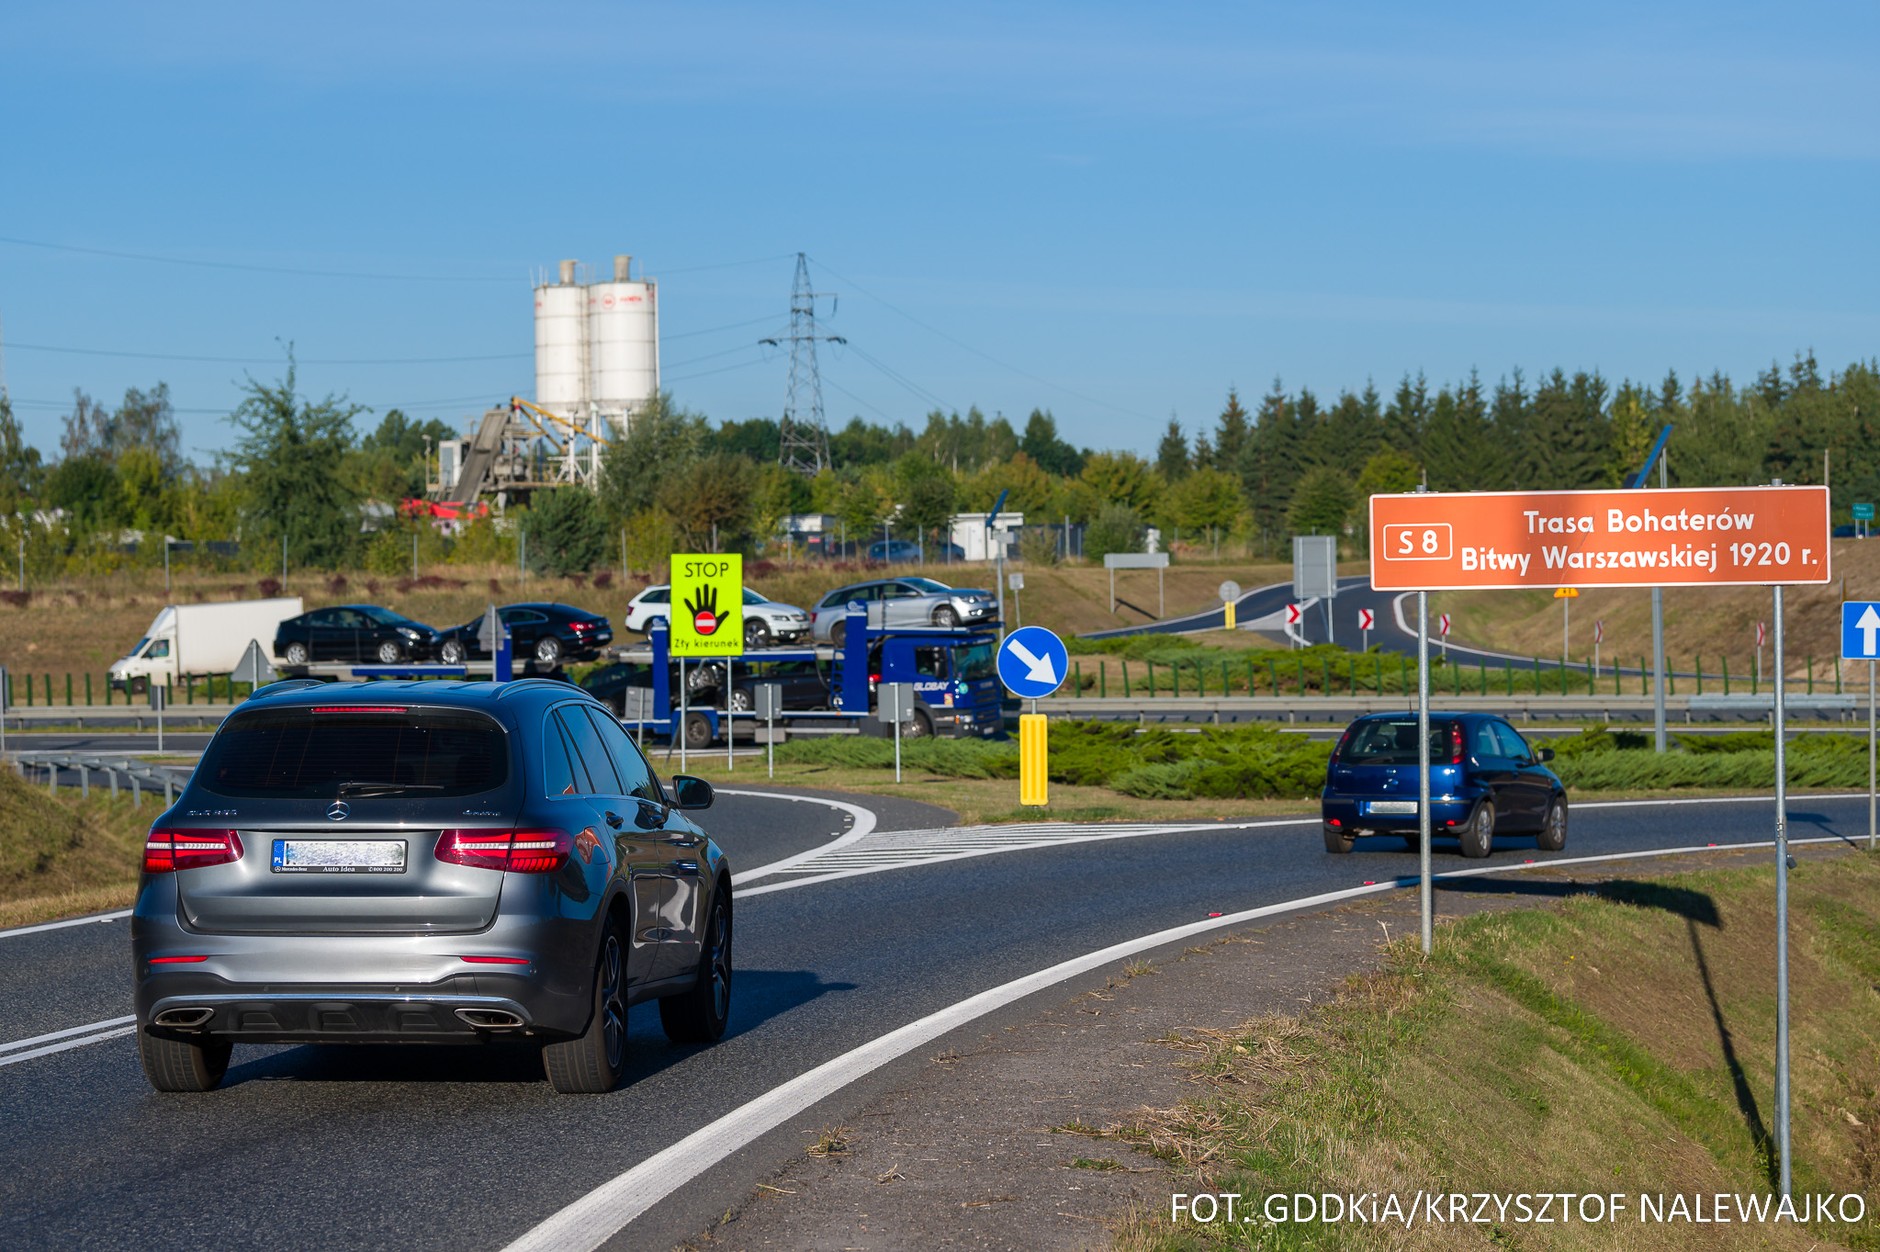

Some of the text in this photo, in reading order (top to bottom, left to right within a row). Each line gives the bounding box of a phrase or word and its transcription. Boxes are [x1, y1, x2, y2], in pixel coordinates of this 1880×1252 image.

[1523, 507, 1755, 534] Trasa Bohaterów
[1398, 529, 1439, 555] S 8
[1461, 541, 1818, 577] Bitwy Warszawskiej 1920 r.
[684, 562, 729, 578] STOP
[674, 638, 739, 650] Zły kierunek
[273, 856, 283, 864] PL
